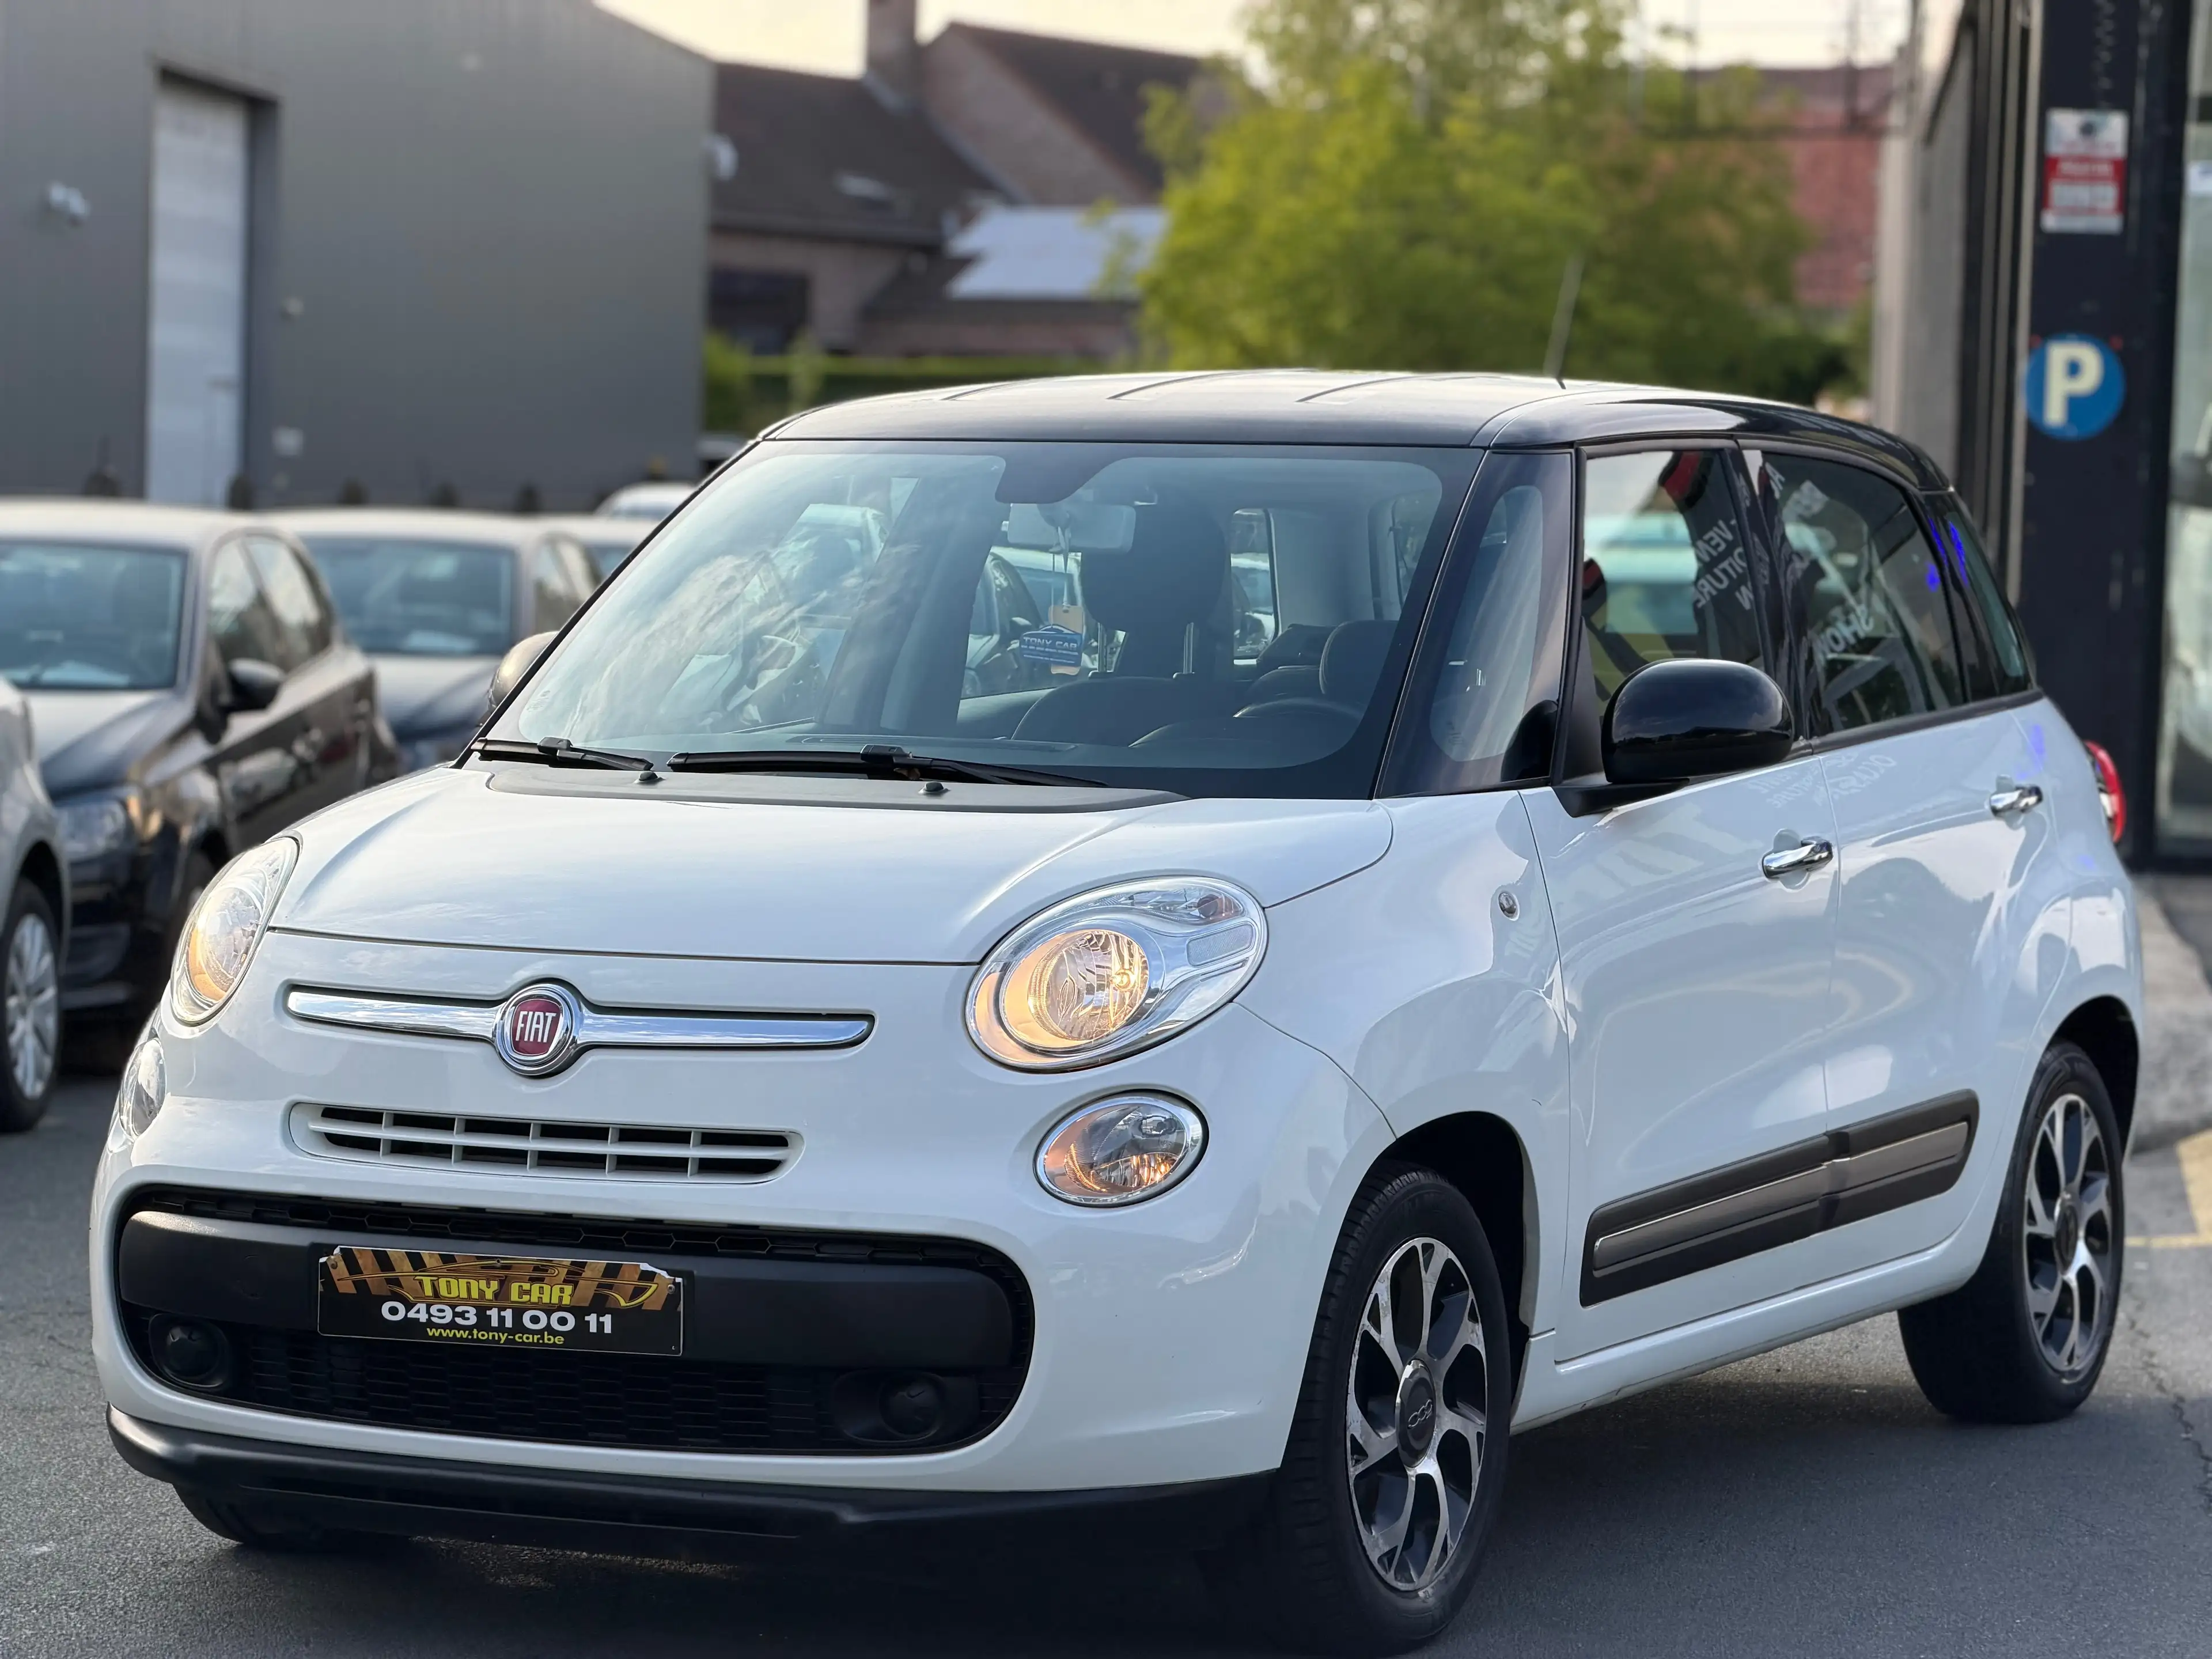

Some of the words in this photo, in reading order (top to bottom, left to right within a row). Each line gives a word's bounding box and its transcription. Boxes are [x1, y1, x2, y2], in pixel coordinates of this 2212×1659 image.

[2044, 342, 2104, 427] P
[1023, 637, 1052, 646] TONY
[515, 1010, 557, 1043] FIAT
[414, 1275, 499, 1301] TONY
[510, 1282, 574, 1306] CAR
[381, 1301, 478, 1326] 0493
[486, 1307, 513, 1328] 11
[522, 1309, 575, 1332] 00
[584, 1313, 612, 1334] 11
[426, 1327, 565, 1345] www.tony-car.be
